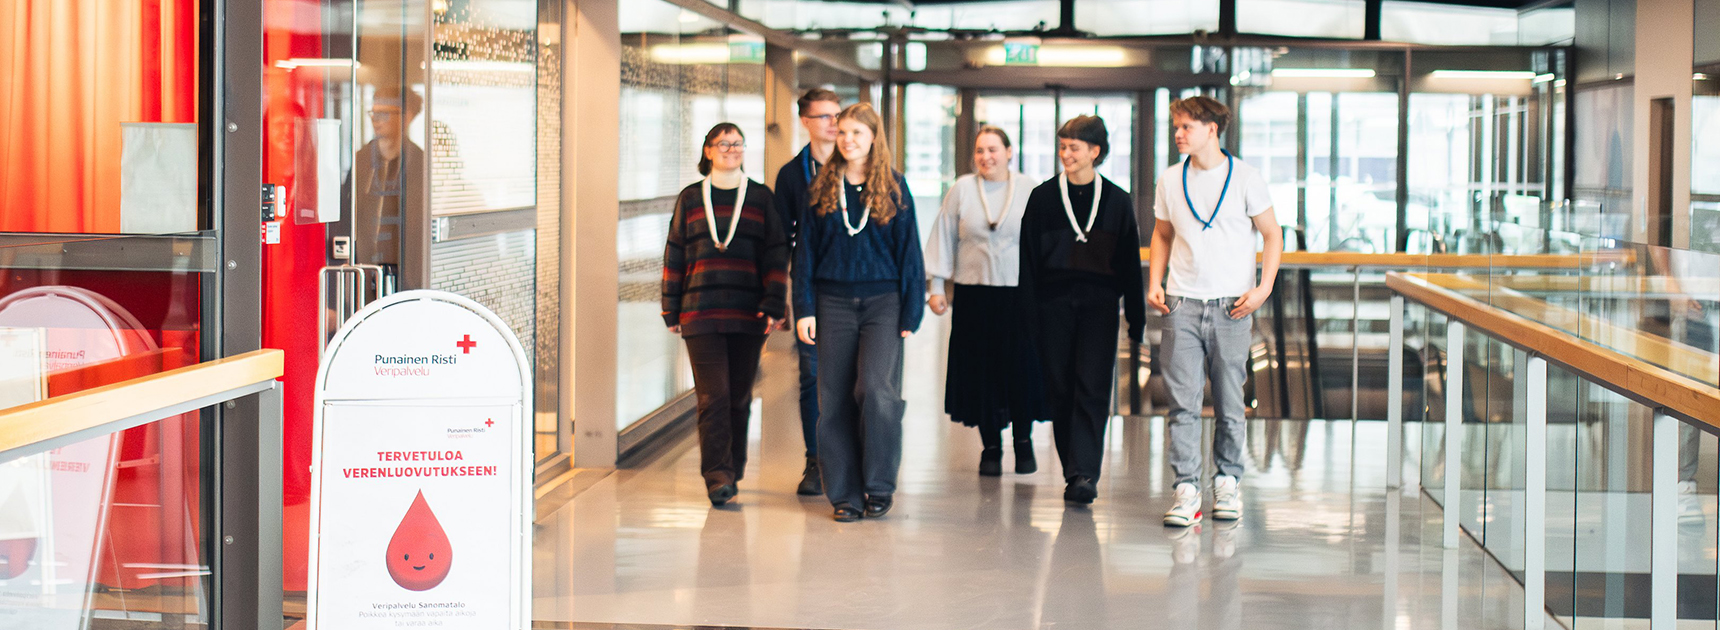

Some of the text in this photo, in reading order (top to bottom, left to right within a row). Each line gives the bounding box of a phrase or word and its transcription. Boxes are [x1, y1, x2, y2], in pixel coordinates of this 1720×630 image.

[374, 354, 457, 364] Punainen Risti
[374, 366, 430, 378] Veripalvelu
[377, 451, 463, 461] TERVETULOA
[343, 466, 497, 478] VERENLUOVUTUKSEEN!
[372, 602, 416, 610] Veripalvelu
